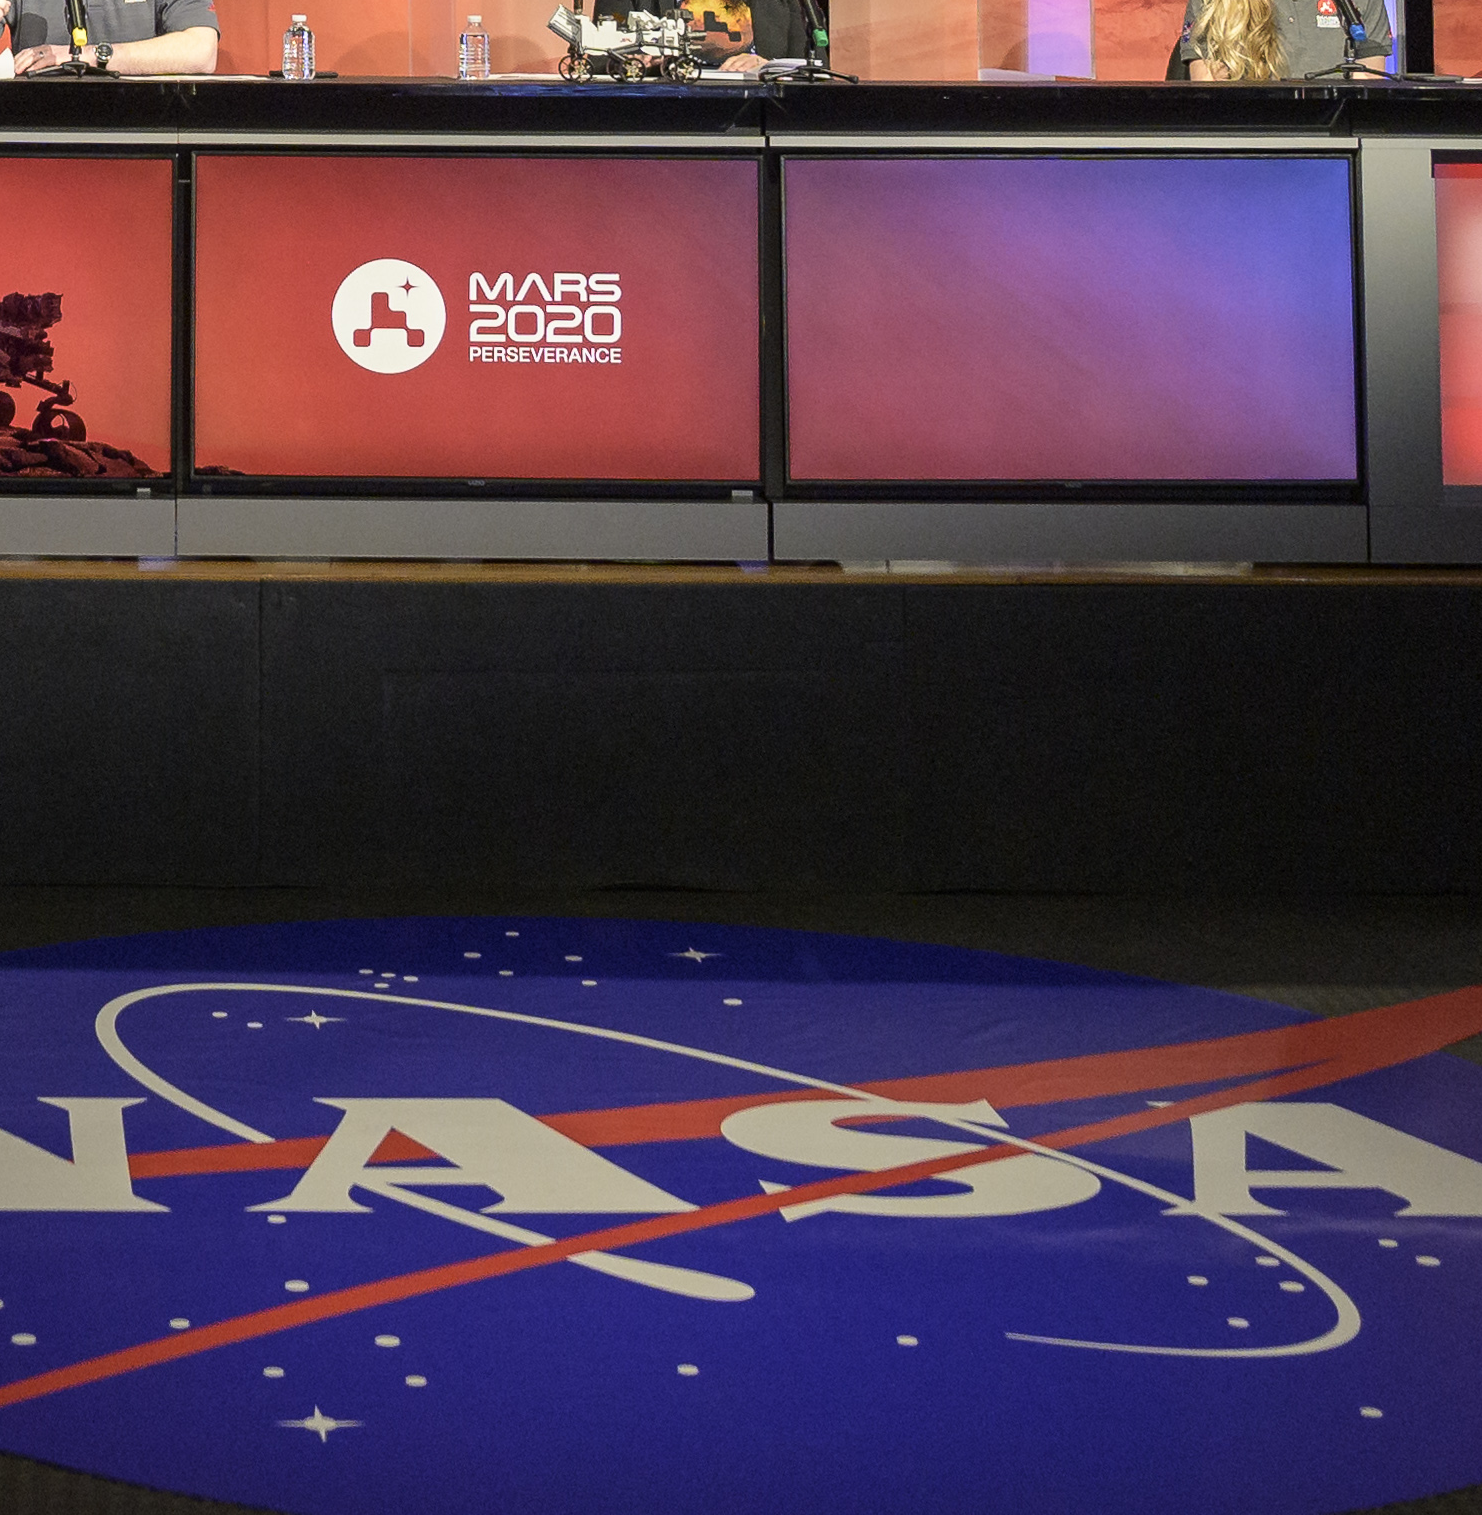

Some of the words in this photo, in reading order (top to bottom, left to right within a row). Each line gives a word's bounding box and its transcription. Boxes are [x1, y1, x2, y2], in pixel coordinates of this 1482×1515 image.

[469, 272, 622, 302] MARS
[469, 304, 623, 344] 2020
[469, 346, 622, 364] PERSEVERANCE
